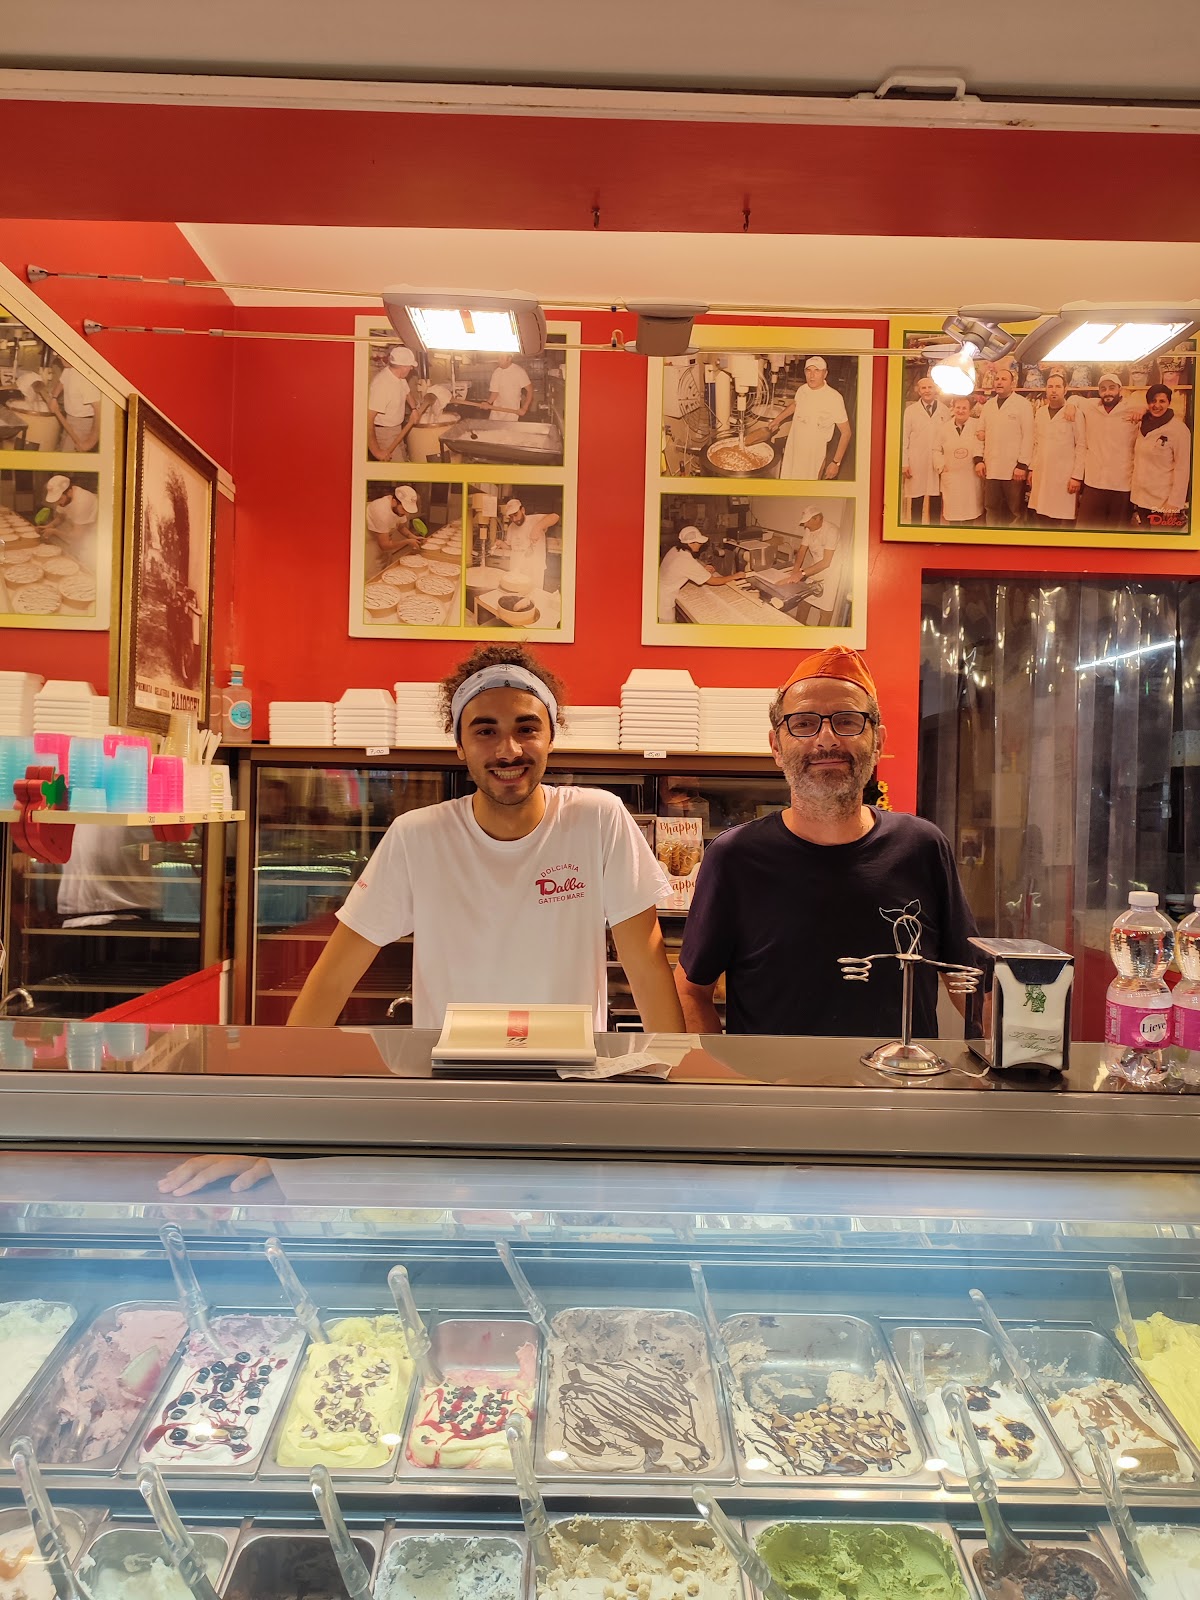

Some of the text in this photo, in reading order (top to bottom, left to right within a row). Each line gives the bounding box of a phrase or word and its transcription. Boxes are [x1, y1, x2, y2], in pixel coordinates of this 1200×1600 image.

[1147, 514, 1183, 526] Dalba
[540, 863, 579, 878] DOLCIARIA
[535, 877, 587, 896] Dalba
[538, 891, 585, 905] GATTEO MARE
[1142, 1022, 1166, 1034] Lieve
